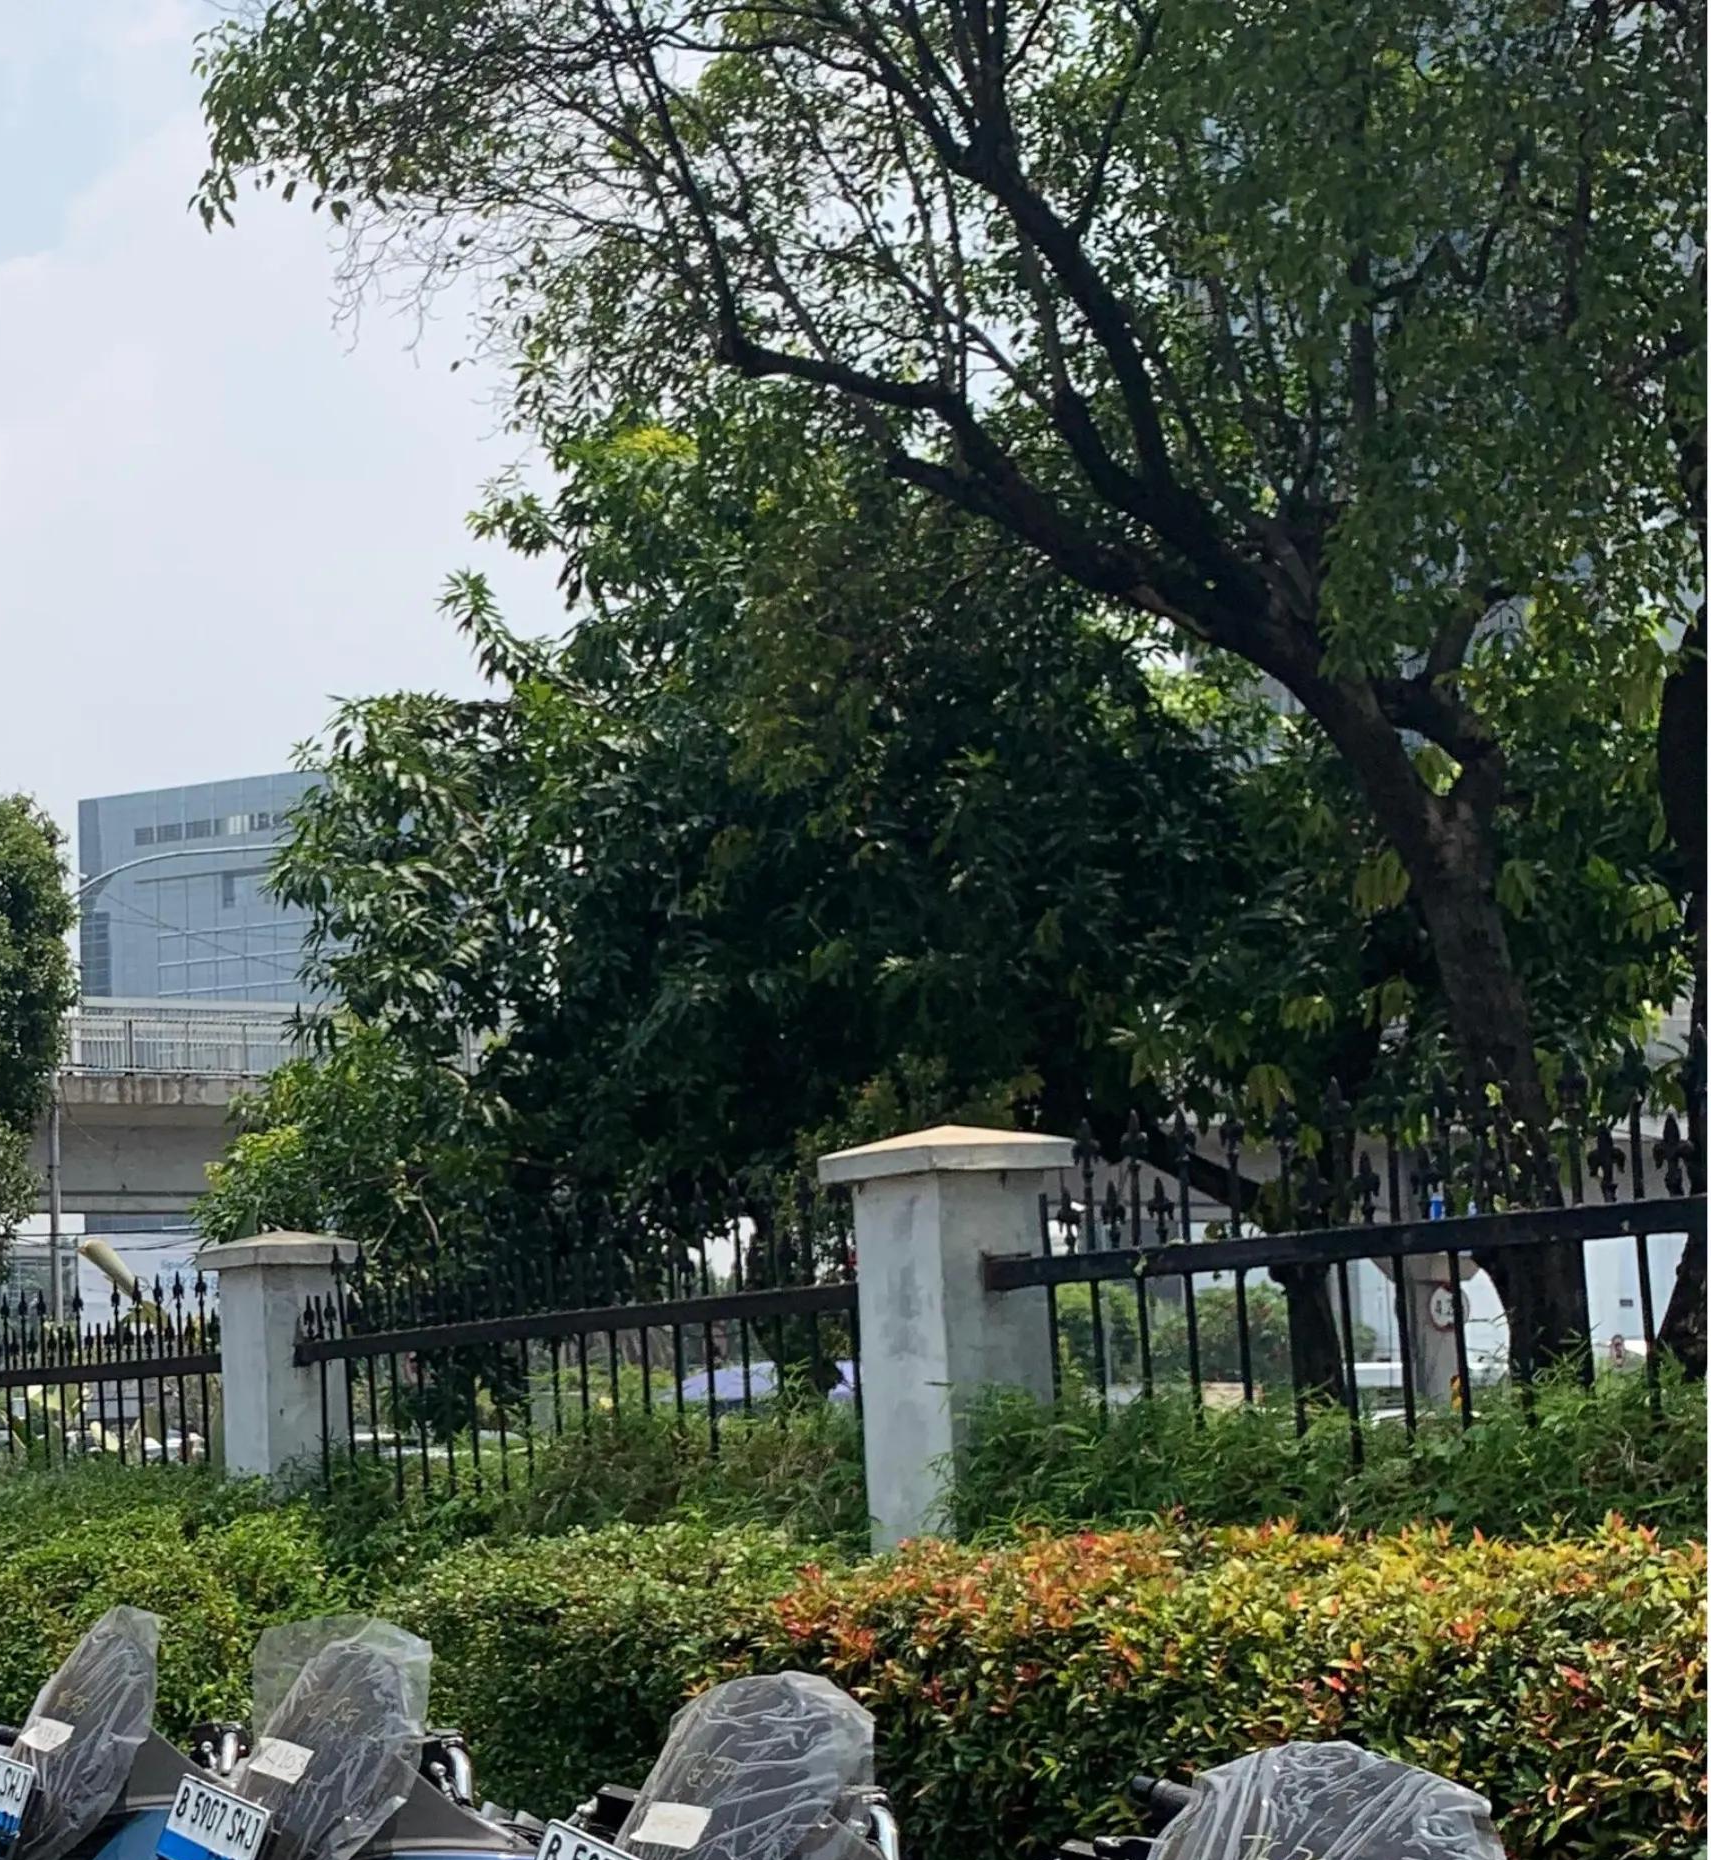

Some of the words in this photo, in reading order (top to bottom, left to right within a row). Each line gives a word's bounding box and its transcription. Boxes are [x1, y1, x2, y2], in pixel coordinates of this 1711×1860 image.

[0, 1767, 28, 1802] SWJ
[176, 1786, 191, 1817] B
[191, 1791, 228, 1836] 5907
[226, 1808, 261, 1849] SWJ
